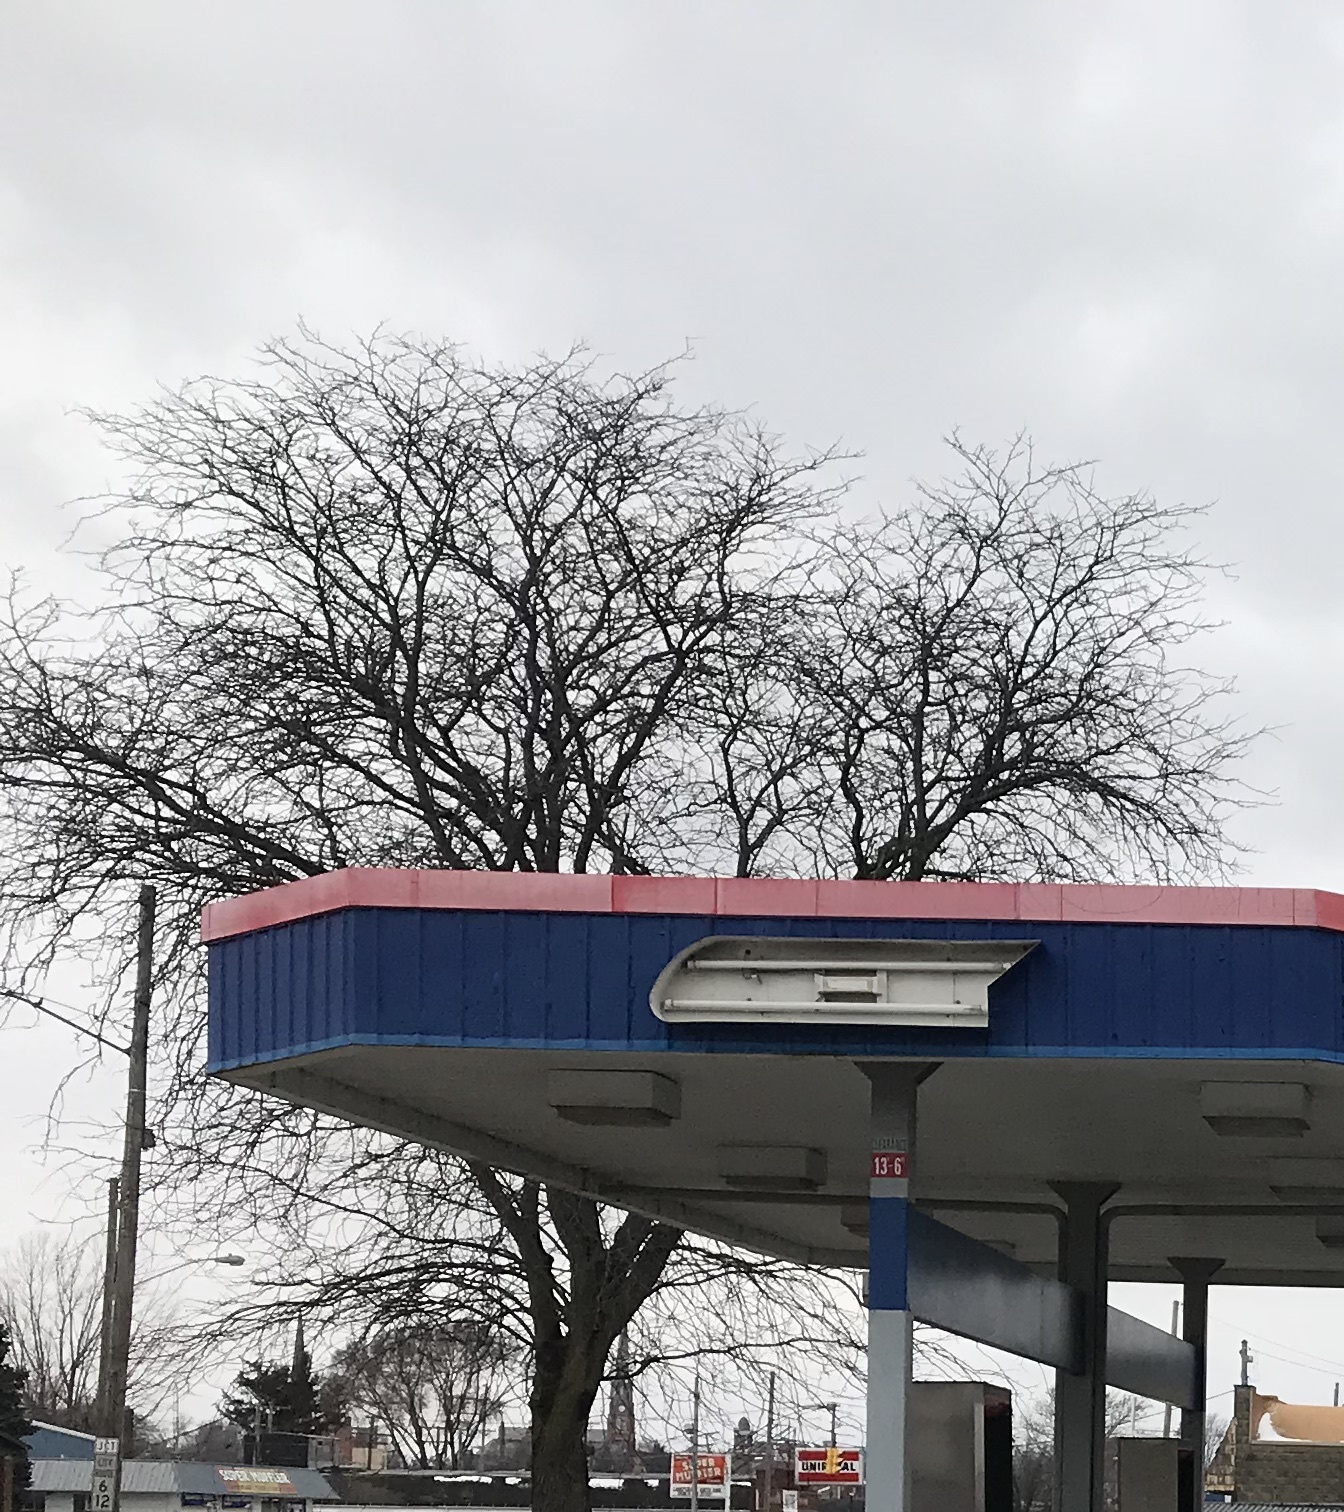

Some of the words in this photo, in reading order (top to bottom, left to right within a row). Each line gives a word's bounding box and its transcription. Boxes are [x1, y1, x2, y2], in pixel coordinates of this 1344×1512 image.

[801, 1461, 857, 1472] UNIRAL
[99, 1479, 108, 1493] 6
[95, 1494, 110, 1509] 12
